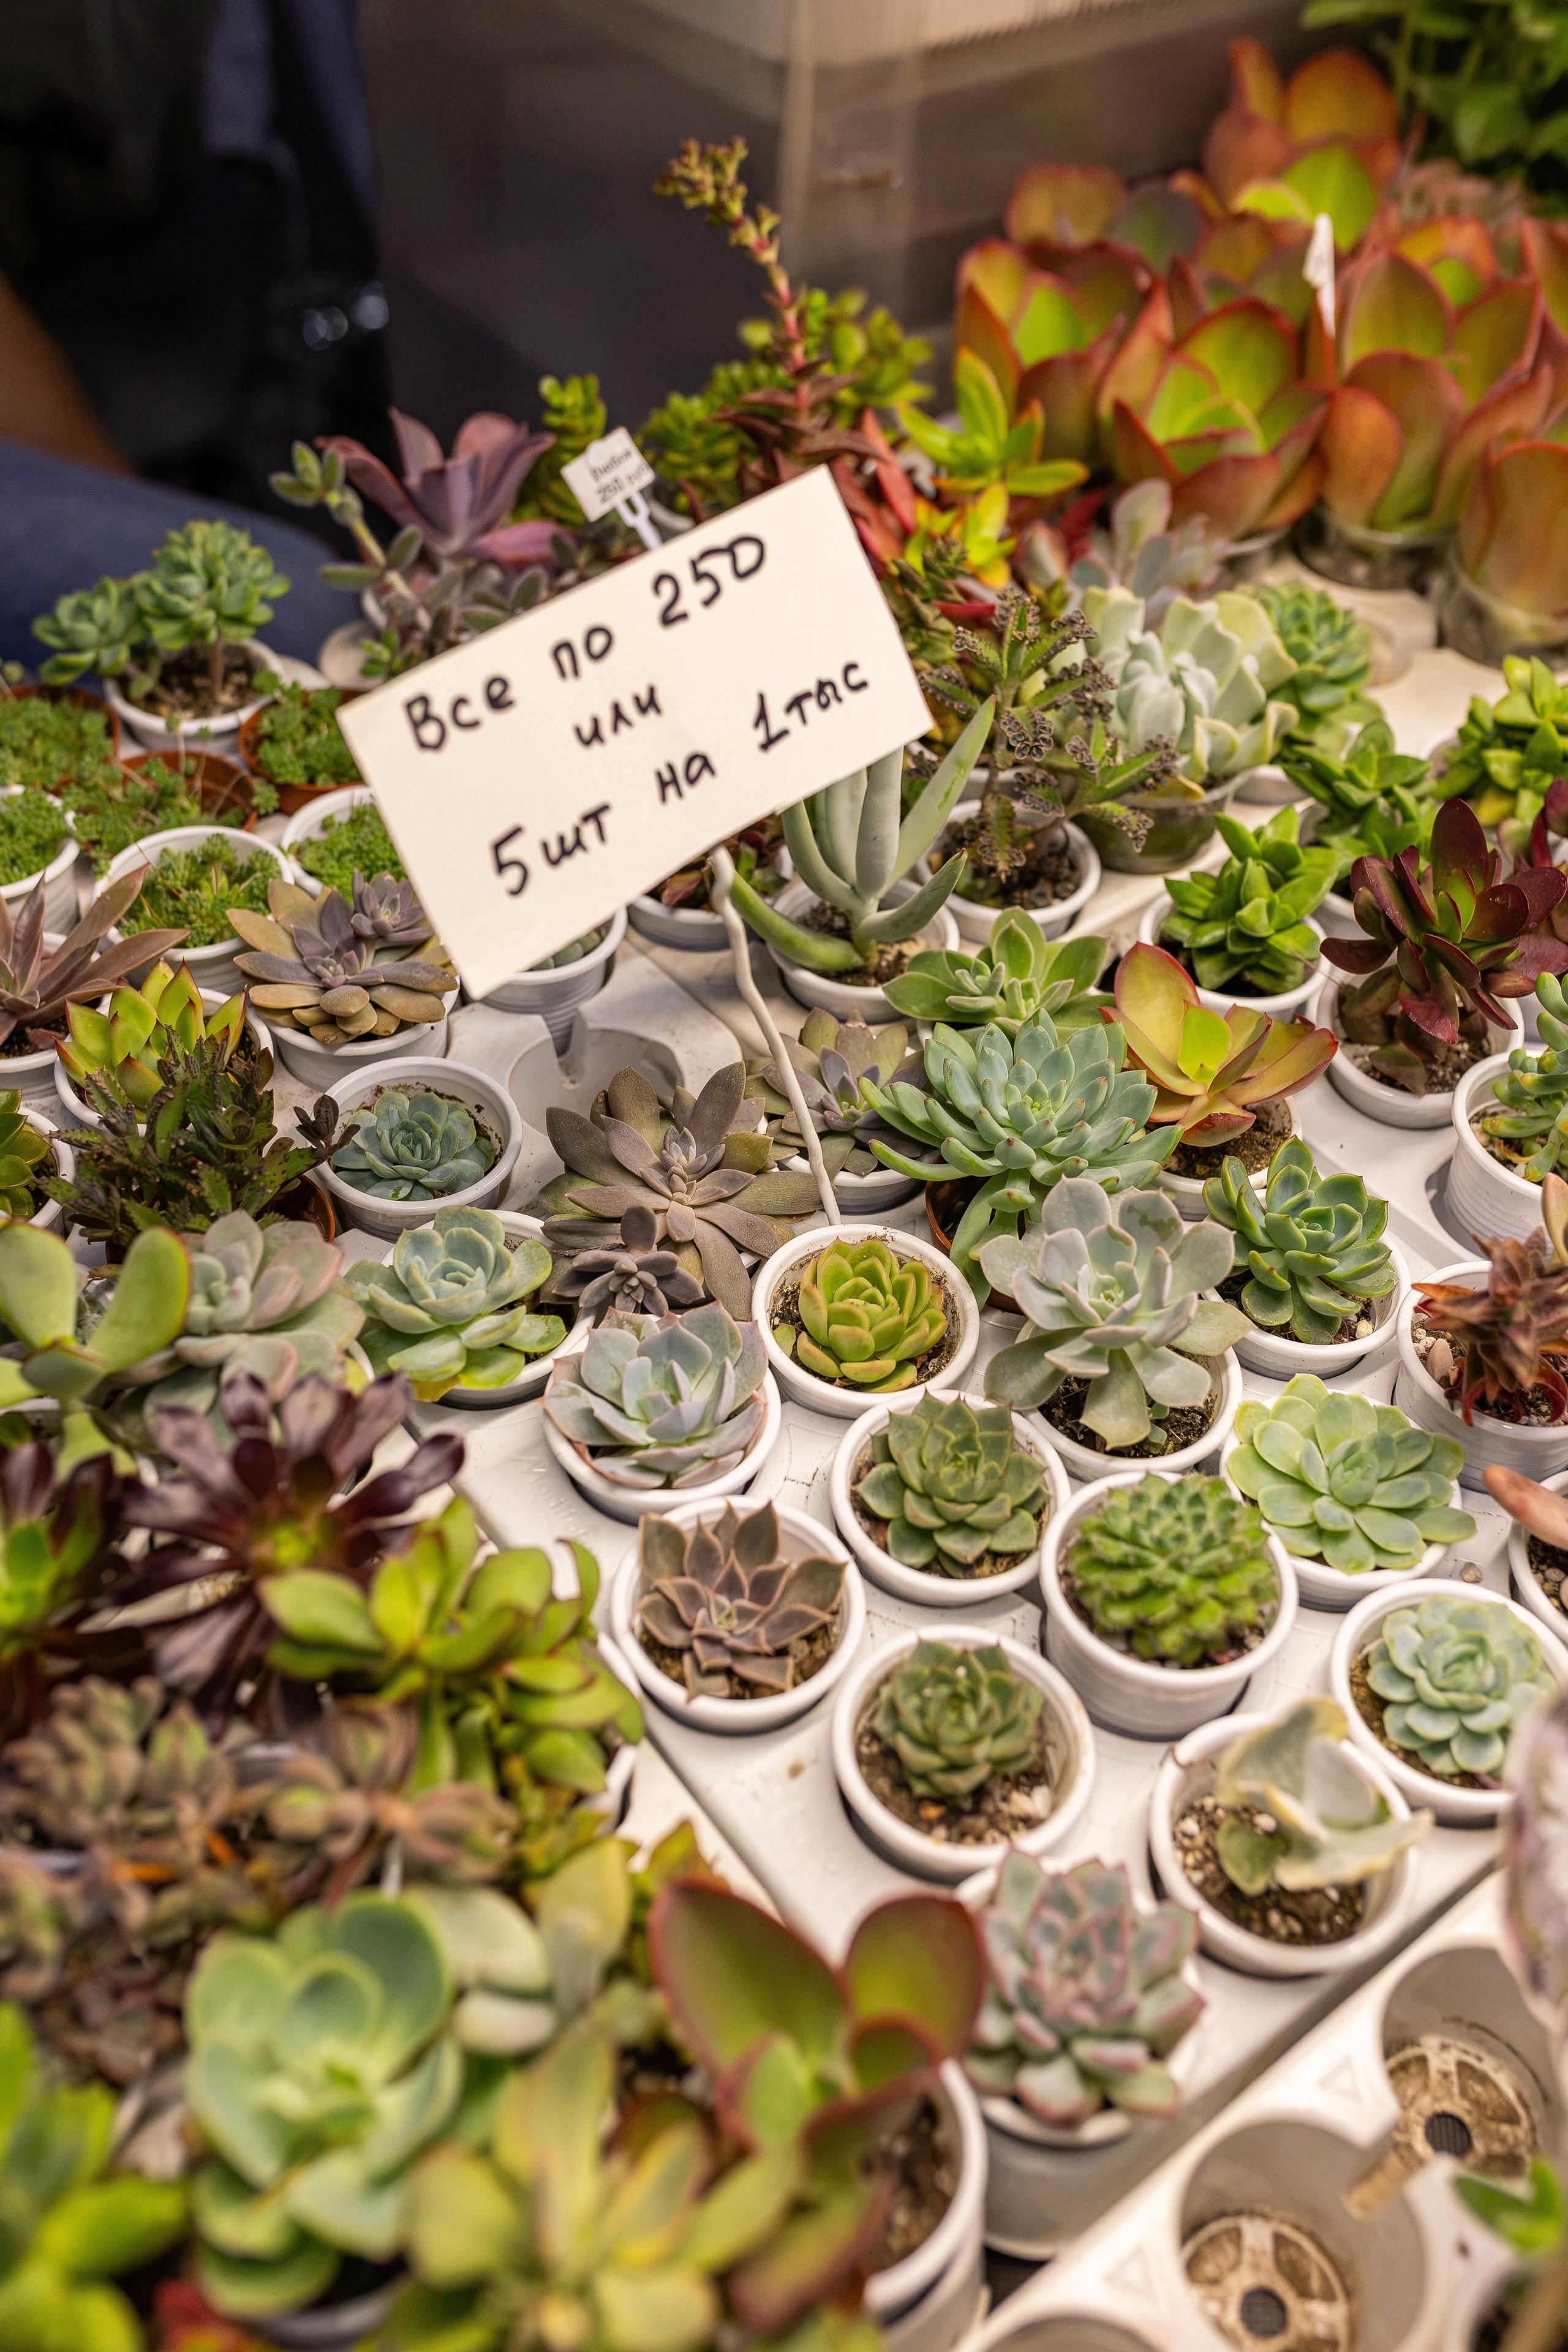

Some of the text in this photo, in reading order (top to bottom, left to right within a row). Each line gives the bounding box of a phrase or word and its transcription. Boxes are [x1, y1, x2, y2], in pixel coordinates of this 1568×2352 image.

[403, 534, 766, 753] Все по 250
[573, 684, 663, 748] или
[654, 752, 717, 805] на
